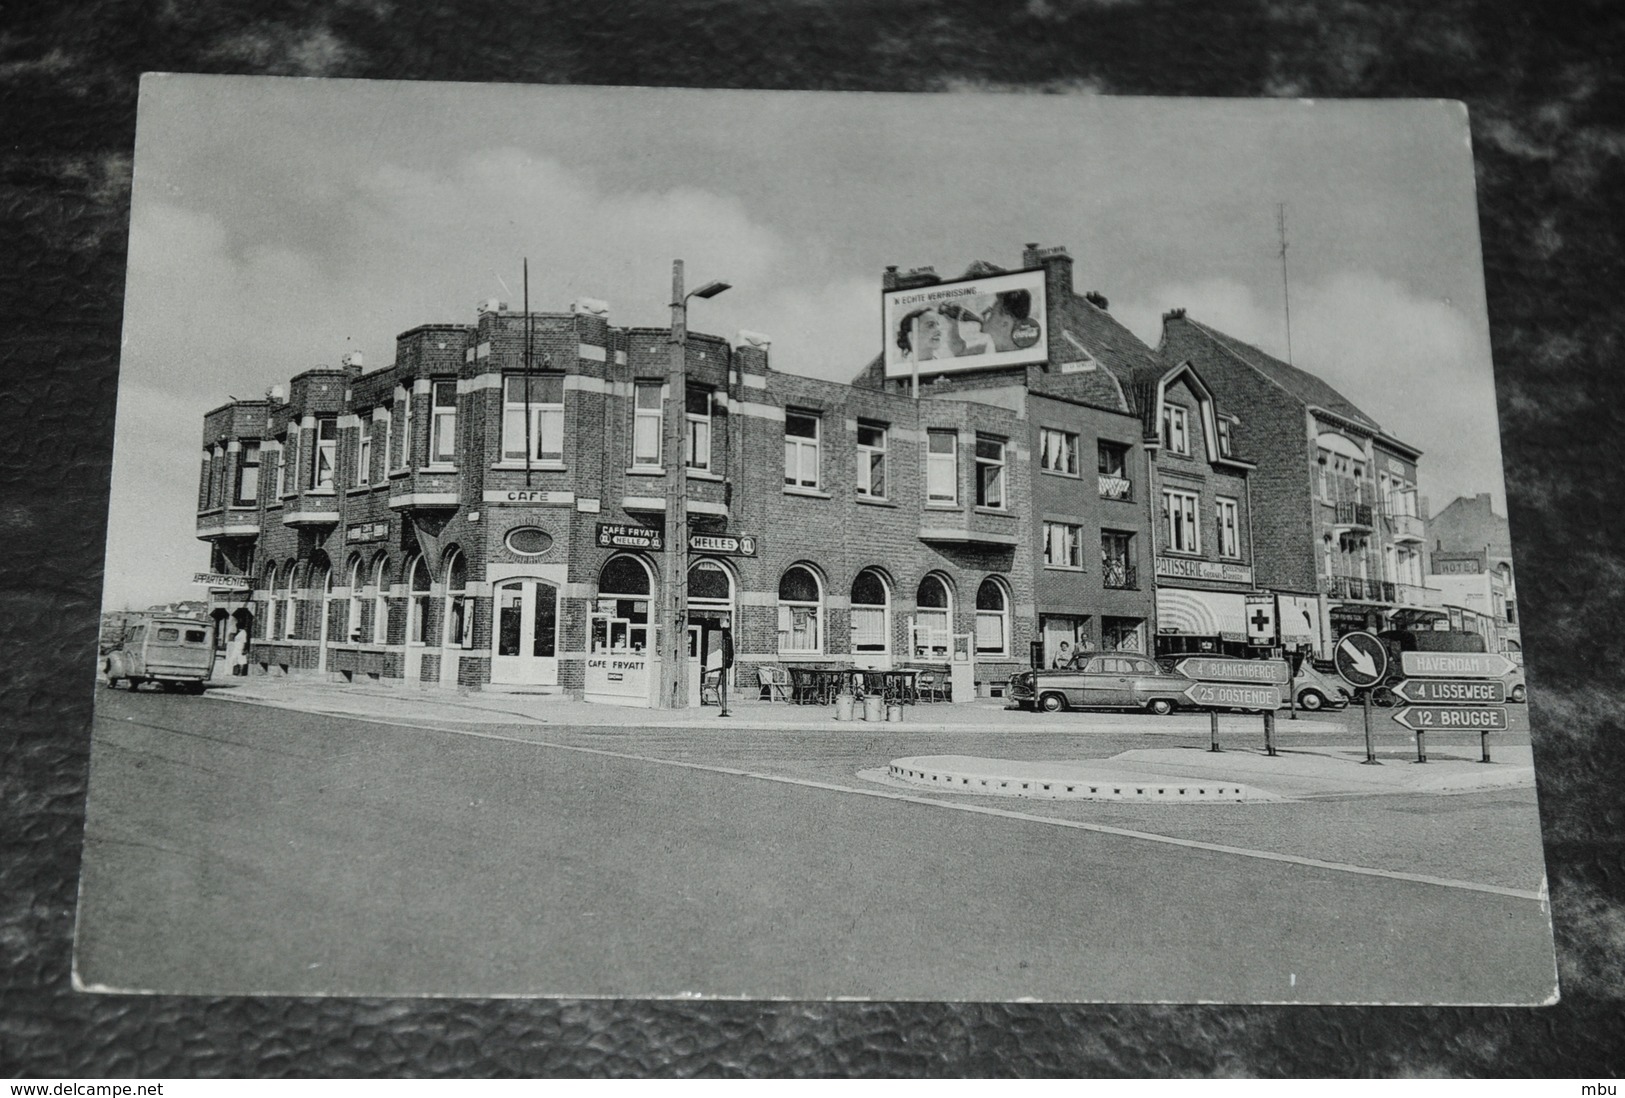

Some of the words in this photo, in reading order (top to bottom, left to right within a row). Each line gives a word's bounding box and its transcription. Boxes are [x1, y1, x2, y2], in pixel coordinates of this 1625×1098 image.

[507, 492, 549, 502] CAFE
[628, 528, 660, 539] FRYATT
[616, 537, 648, 545] HELLES
[694, 537, 735, 550] HELLES
[1155, 557, 1203, 577] PATISSERIE
[1442, 561, 1478, 574] HOTEL
[588, 659, 607, 669] CAFE
[612, 661, 645, 670] FRYATT
[1197, 664, 1204, 675] 4
[1211, 664, 1277, 679] BLANKENBERGE
[1416, 657, 1480, 672] HAVENDAM
[1200, 687, 1214, 701] 25
[1219, 688, 1274, 705] OOSTENDE
[1432, 684, 1496, 699] LISSEWEGE
[1418, 711, 1433, 725] 12
[1440, 711, 1499, 726] BRUGGE
